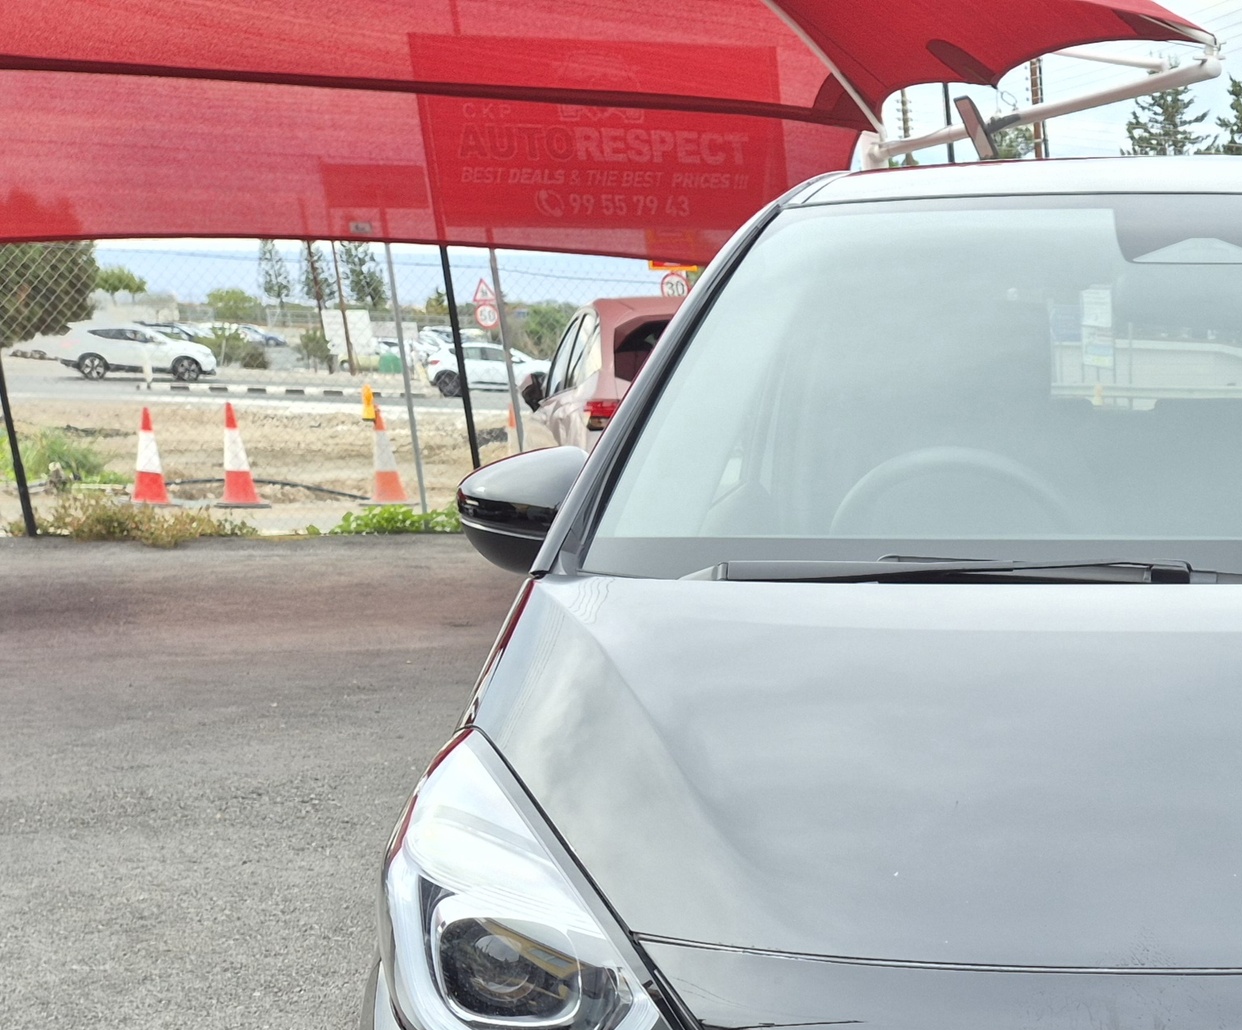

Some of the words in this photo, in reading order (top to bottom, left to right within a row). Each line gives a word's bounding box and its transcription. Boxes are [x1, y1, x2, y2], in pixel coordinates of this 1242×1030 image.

[458, 122, 750, 166] AUTORESPECT
[460, 166, 506, 184] BEST
[508, 168, 565, 185] DEALS
[569, 169, 580, 185] &
[586, 169, 618, 186] THE
[620, 171, 664, 188] BEST
[665, 281, 685, 297] 30
[479, 308, 496, 321] 50
